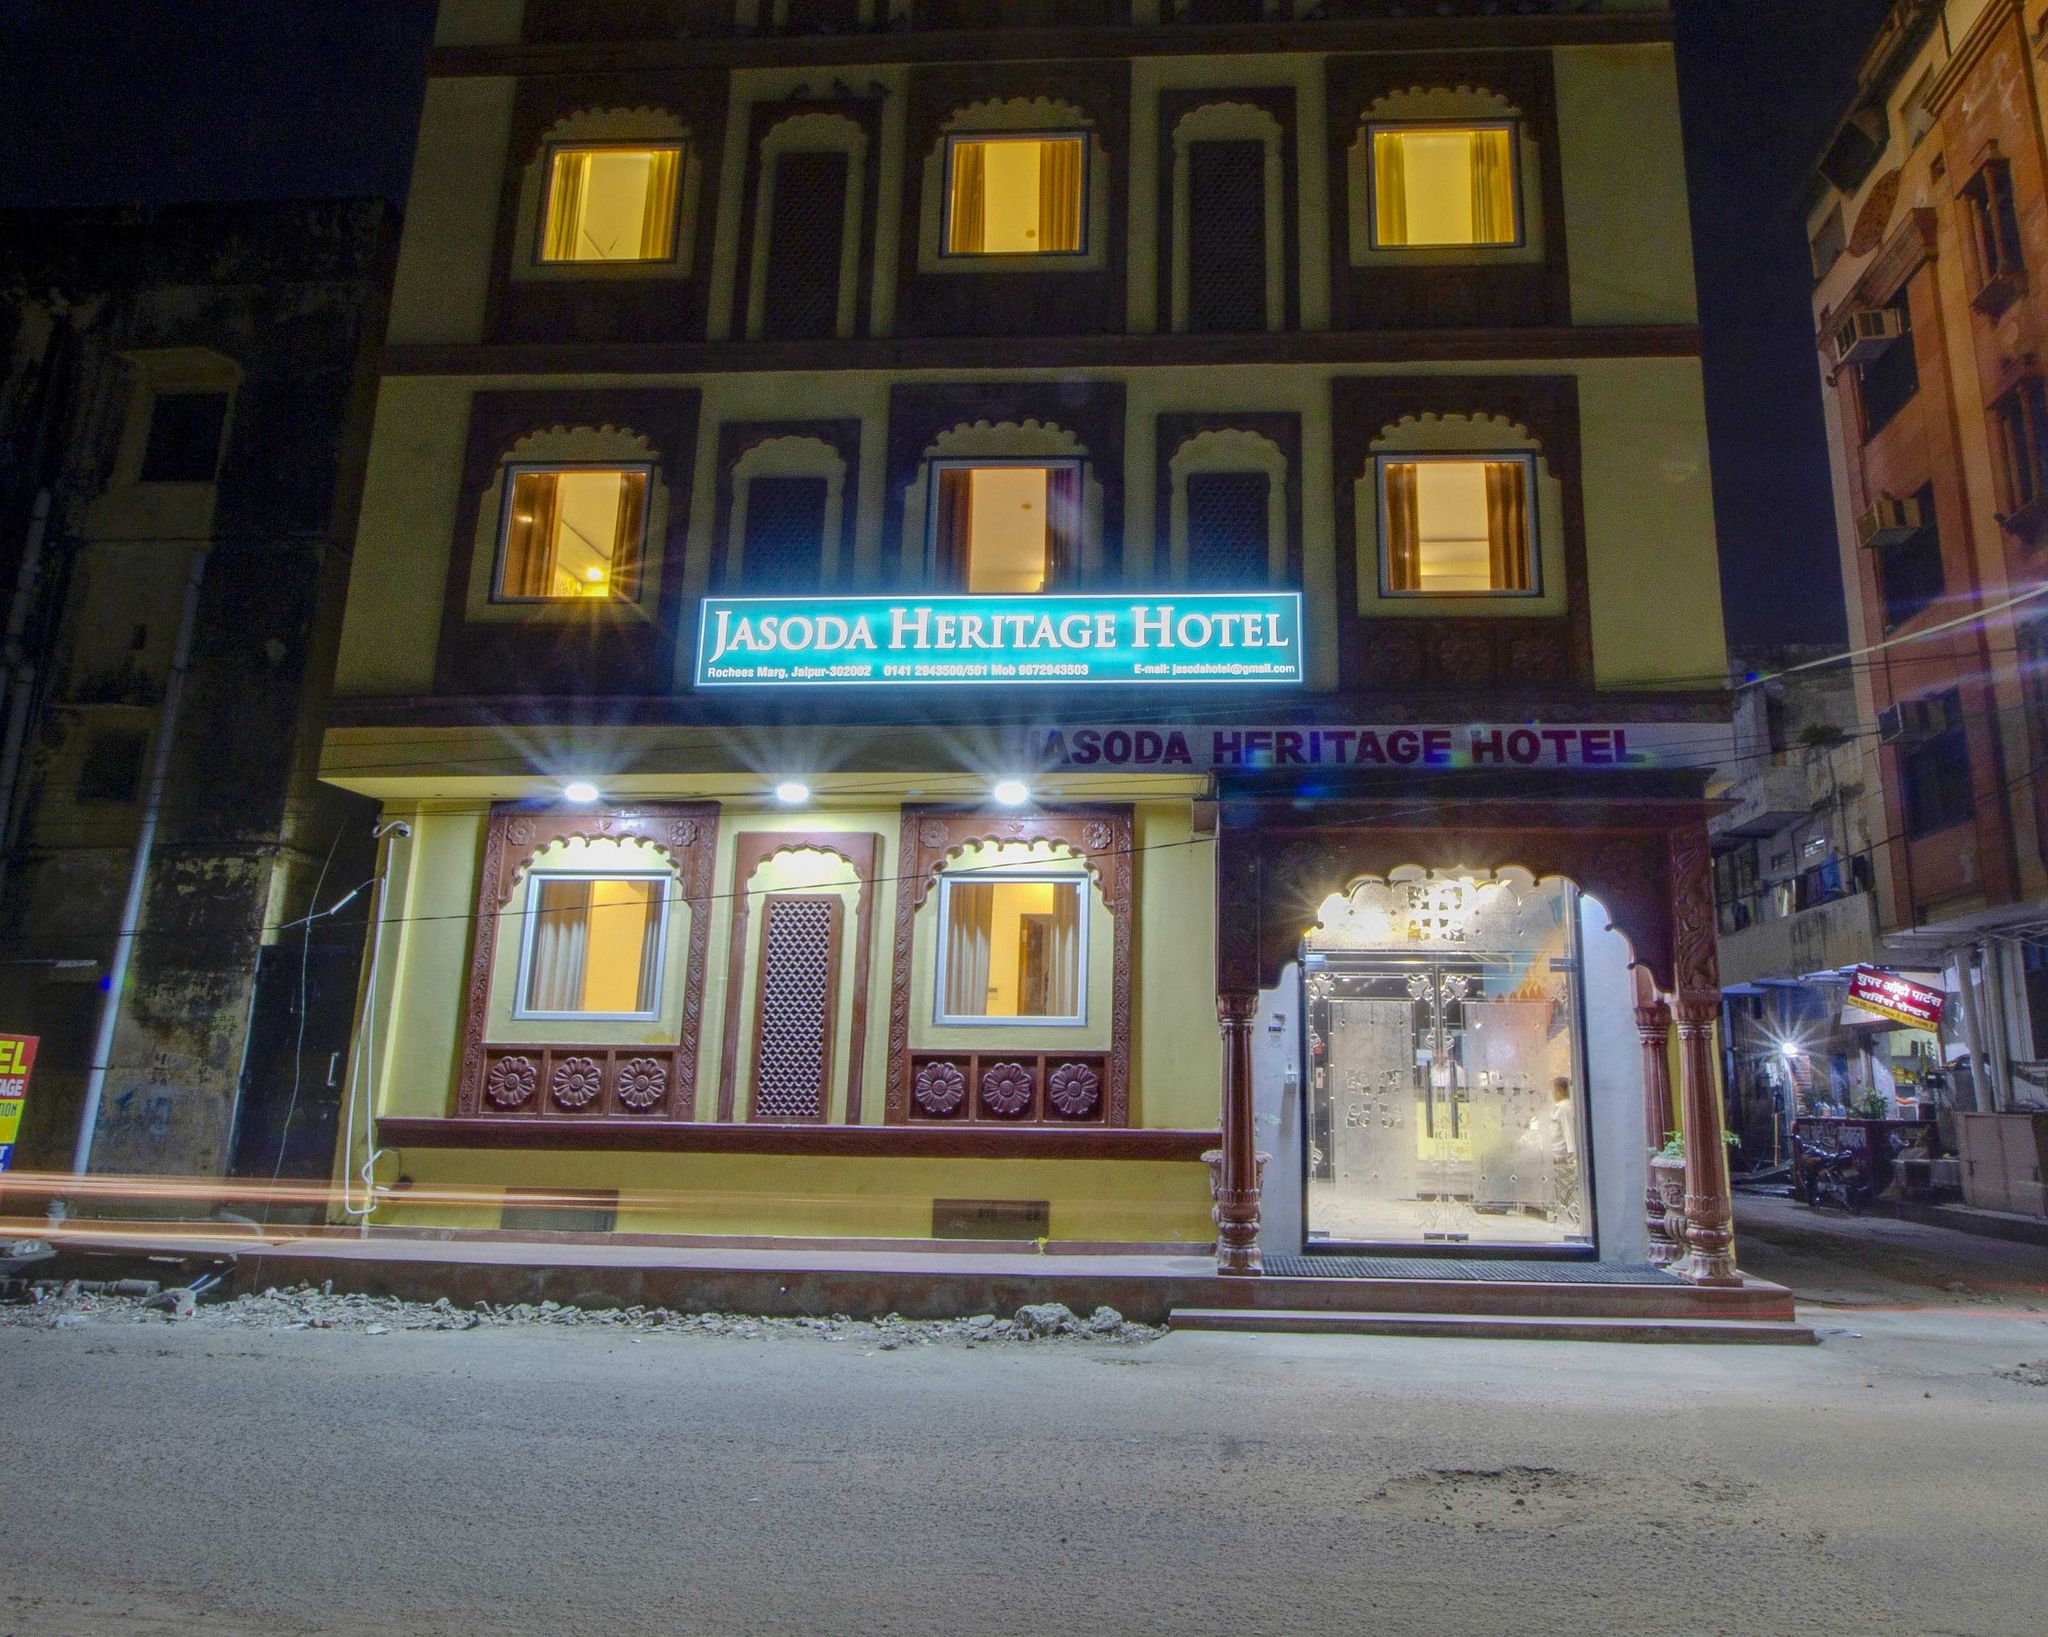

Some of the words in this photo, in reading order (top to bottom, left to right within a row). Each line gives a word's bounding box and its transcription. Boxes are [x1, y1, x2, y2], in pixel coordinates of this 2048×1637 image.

[709, 610, 877, 663] JASODA
[889, 607, 1117, 650] HERITAGE
[1131, 606, 1289, 648] HOTEL
[757, 666, 789, 679] Marg,
[883, 664, 911, 676] 0141
[991, 664, 1016, 676] Mob
[1134, 663, 1170, 674] E-mail:
[1212, 730, 1452, 765] HERITAGE
[1472, 729, 1645, 765] HOTEL
[1857, 972, 1882, 988] सुपर
[1892, 993, 1900, 1001] &
